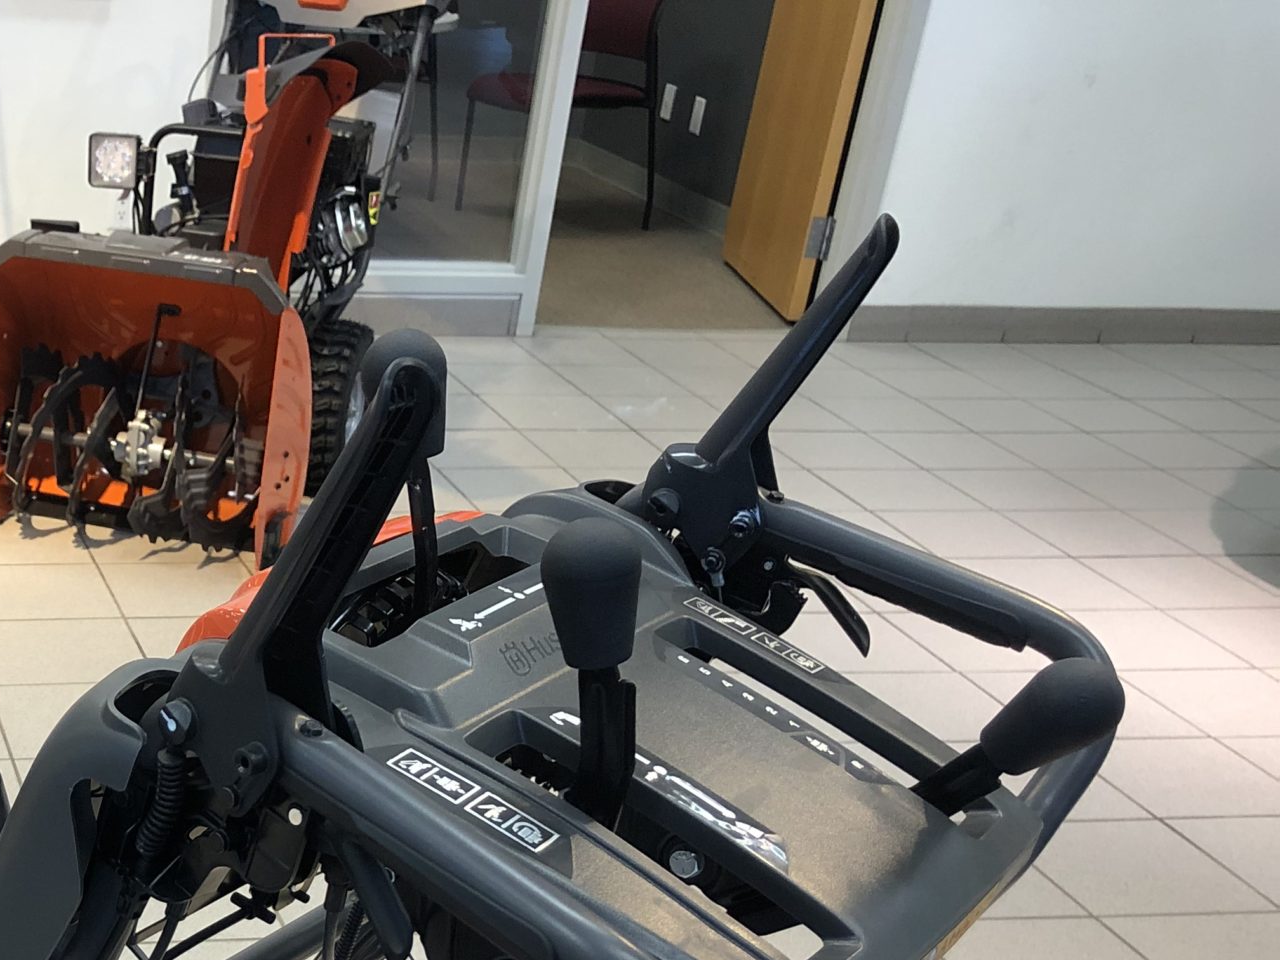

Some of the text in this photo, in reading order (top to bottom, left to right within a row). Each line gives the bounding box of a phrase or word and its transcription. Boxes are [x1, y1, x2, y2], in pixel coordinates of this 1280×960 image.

[698, 667, 712, 675] 5
[721, 679, 734, 688] 4
[742, 692, 755, 702] 3
[764, 706, 779, 716] 2
[788, 720, 801, 728] 1
